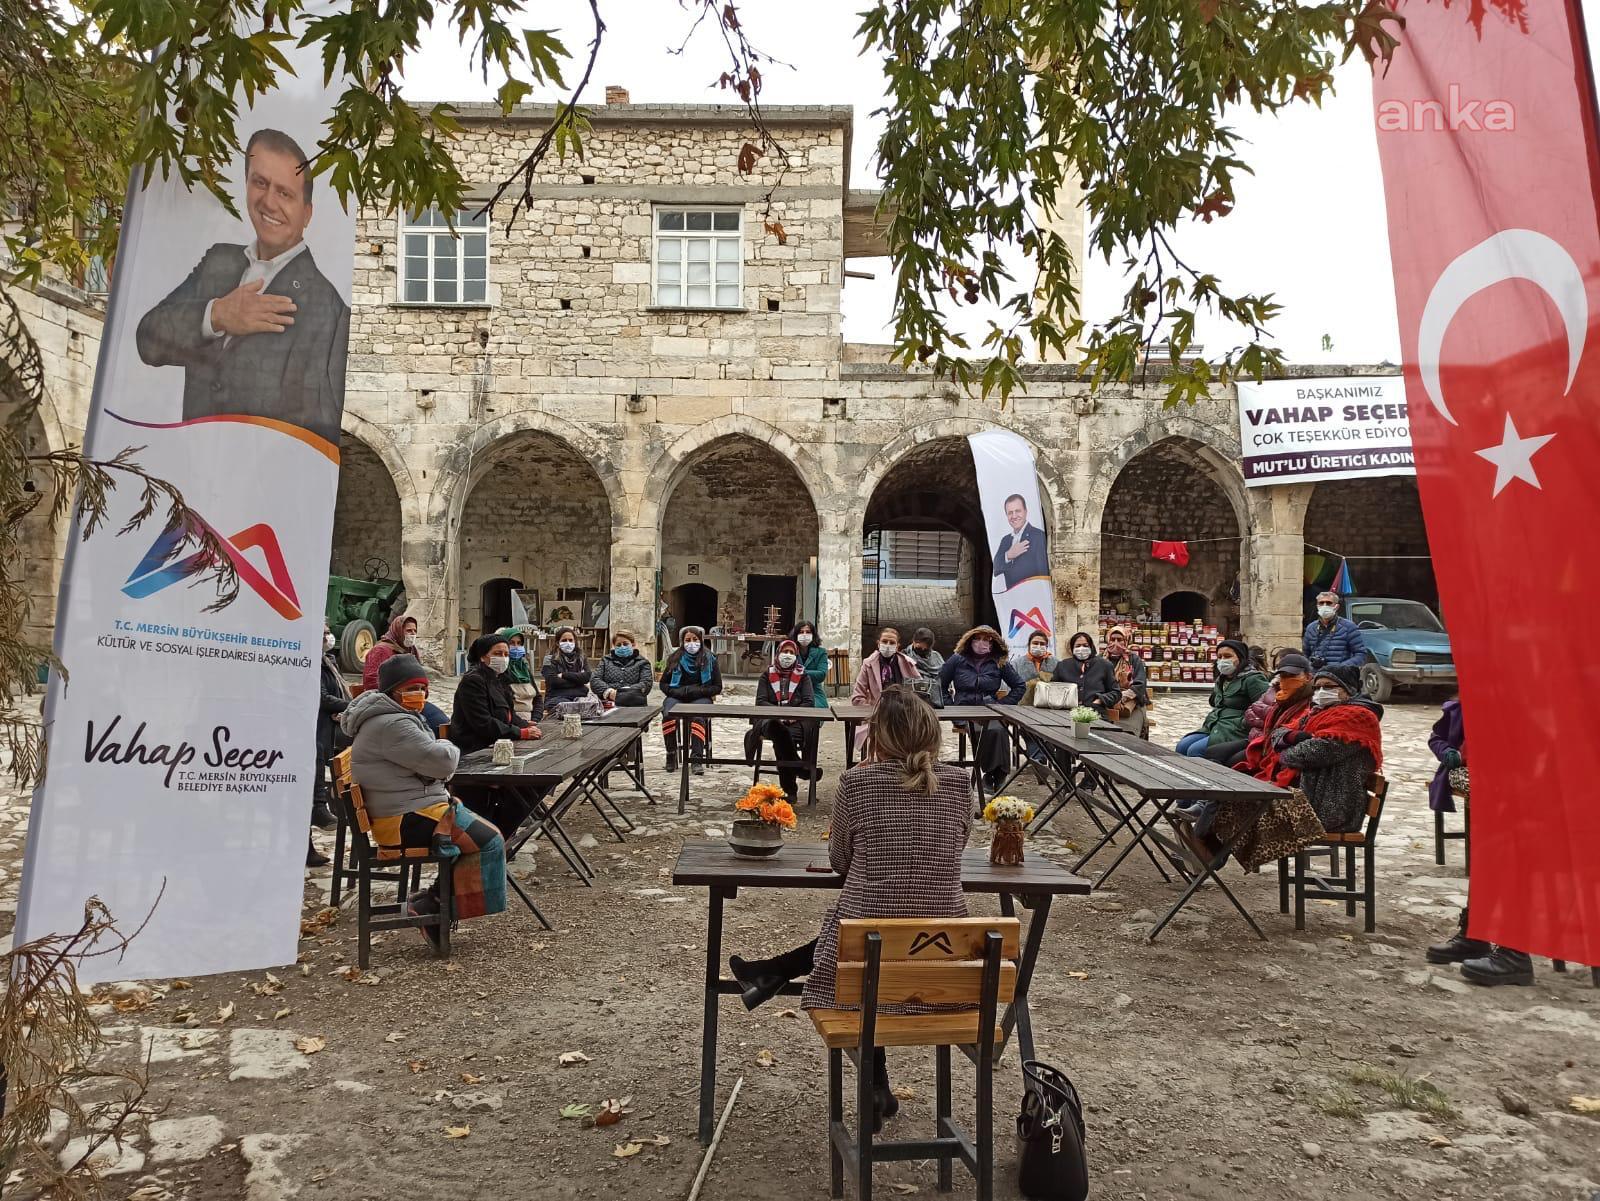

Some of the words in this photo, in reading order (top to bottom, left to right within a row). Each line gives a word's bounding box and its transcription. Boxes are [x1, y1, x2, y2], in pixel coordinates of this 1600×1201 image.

[1297, 386, 1383, 400] BAŞKANIMIZ
[1245, 406, 1333, 426] VAHAP
[1343, 403, 1408, 424] SEÇER
[1253, 432, 1284, 447] ÇOK
[1288, 427, 1361, 443] TEŞEKKÜR
[1366, 426, 1408, 439] EDİYO
[1252, 458, 1307, 474] MUT'LU
[1370, 452, 1415, 465] KADIN
[97, 634, 136, 650] KÜLTÜR
[139, 641, 153, 651] VE
[155, 642, 194, 656] SOSYAL
[115, 620, 133, 631] T.C.
[136, 624, 179, 636] MERSİN
[182, 626, 248, 645] BÜYÜKŞEHİR
[250, 636, 302, 651] BELEDİYESİ
[84, 714, 196, 788] Vahap
[203, 725, 284, 771] Seçer
[178, 771, 196, 780] T.C.
[198, 771, 237, 781] MERSİN
[177, 782, 223, 792] BELEDİYE
[225, 783, 267, 794] BAŞKANI
